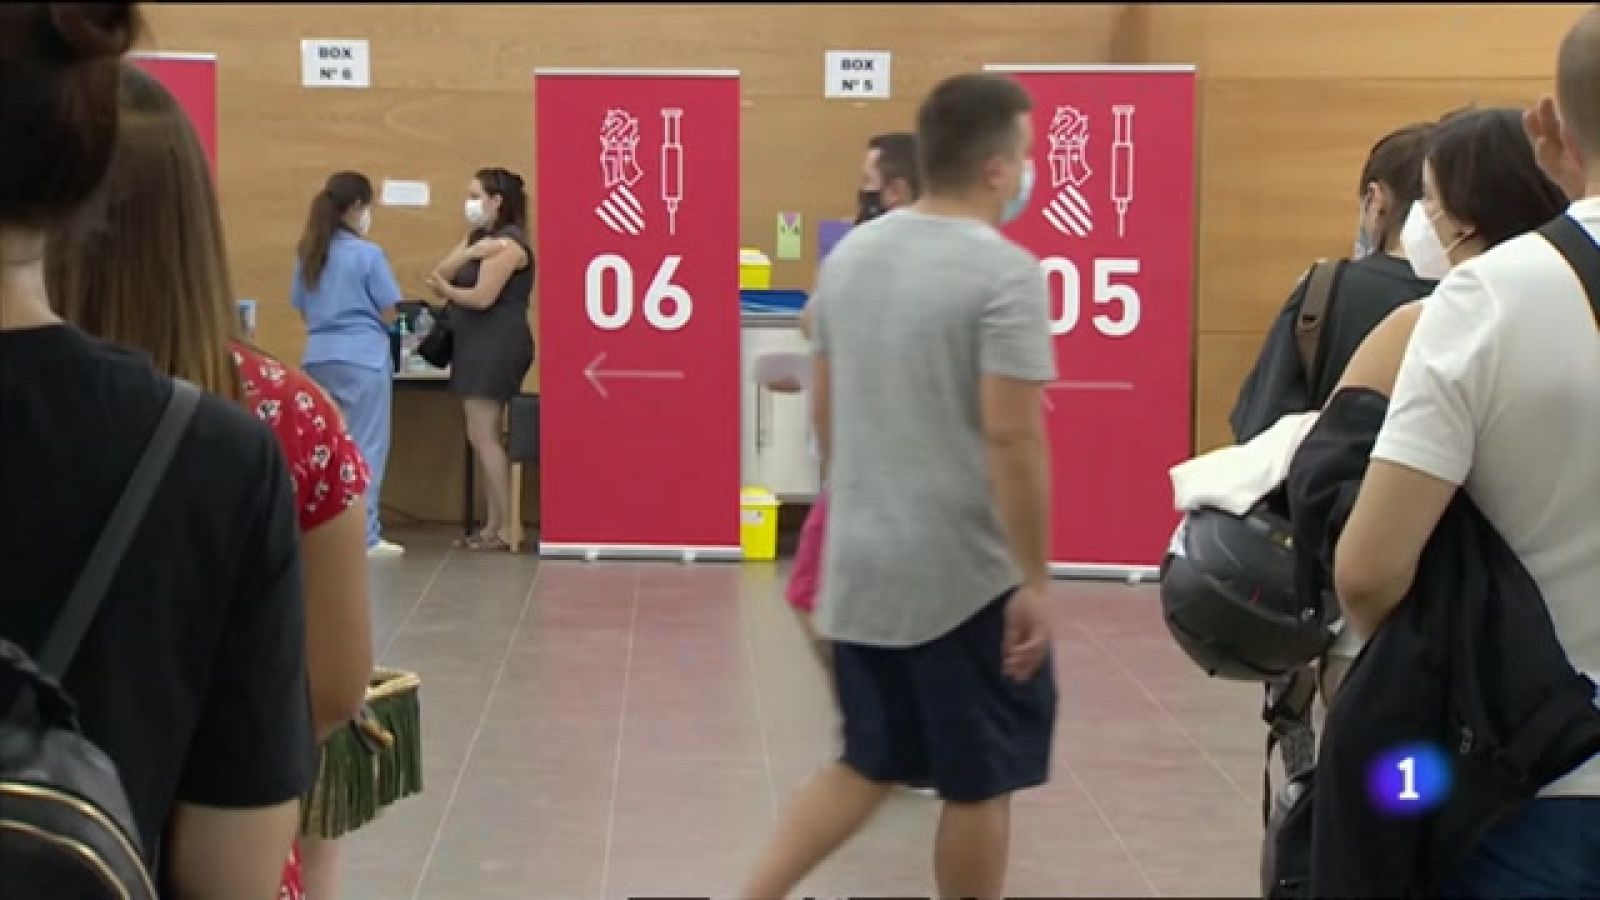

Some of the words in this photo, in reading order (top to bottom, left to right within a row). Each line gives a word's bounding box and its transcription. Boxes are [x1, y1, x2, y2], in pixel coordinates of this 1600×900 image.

[318, 46, 353, 60] BOX
[840, 57, 874, 71] BOX
[863, 79, 874, 91] 5
[584, 253, 694, 330] 06
[1040, 256, 1141, 336] 05
